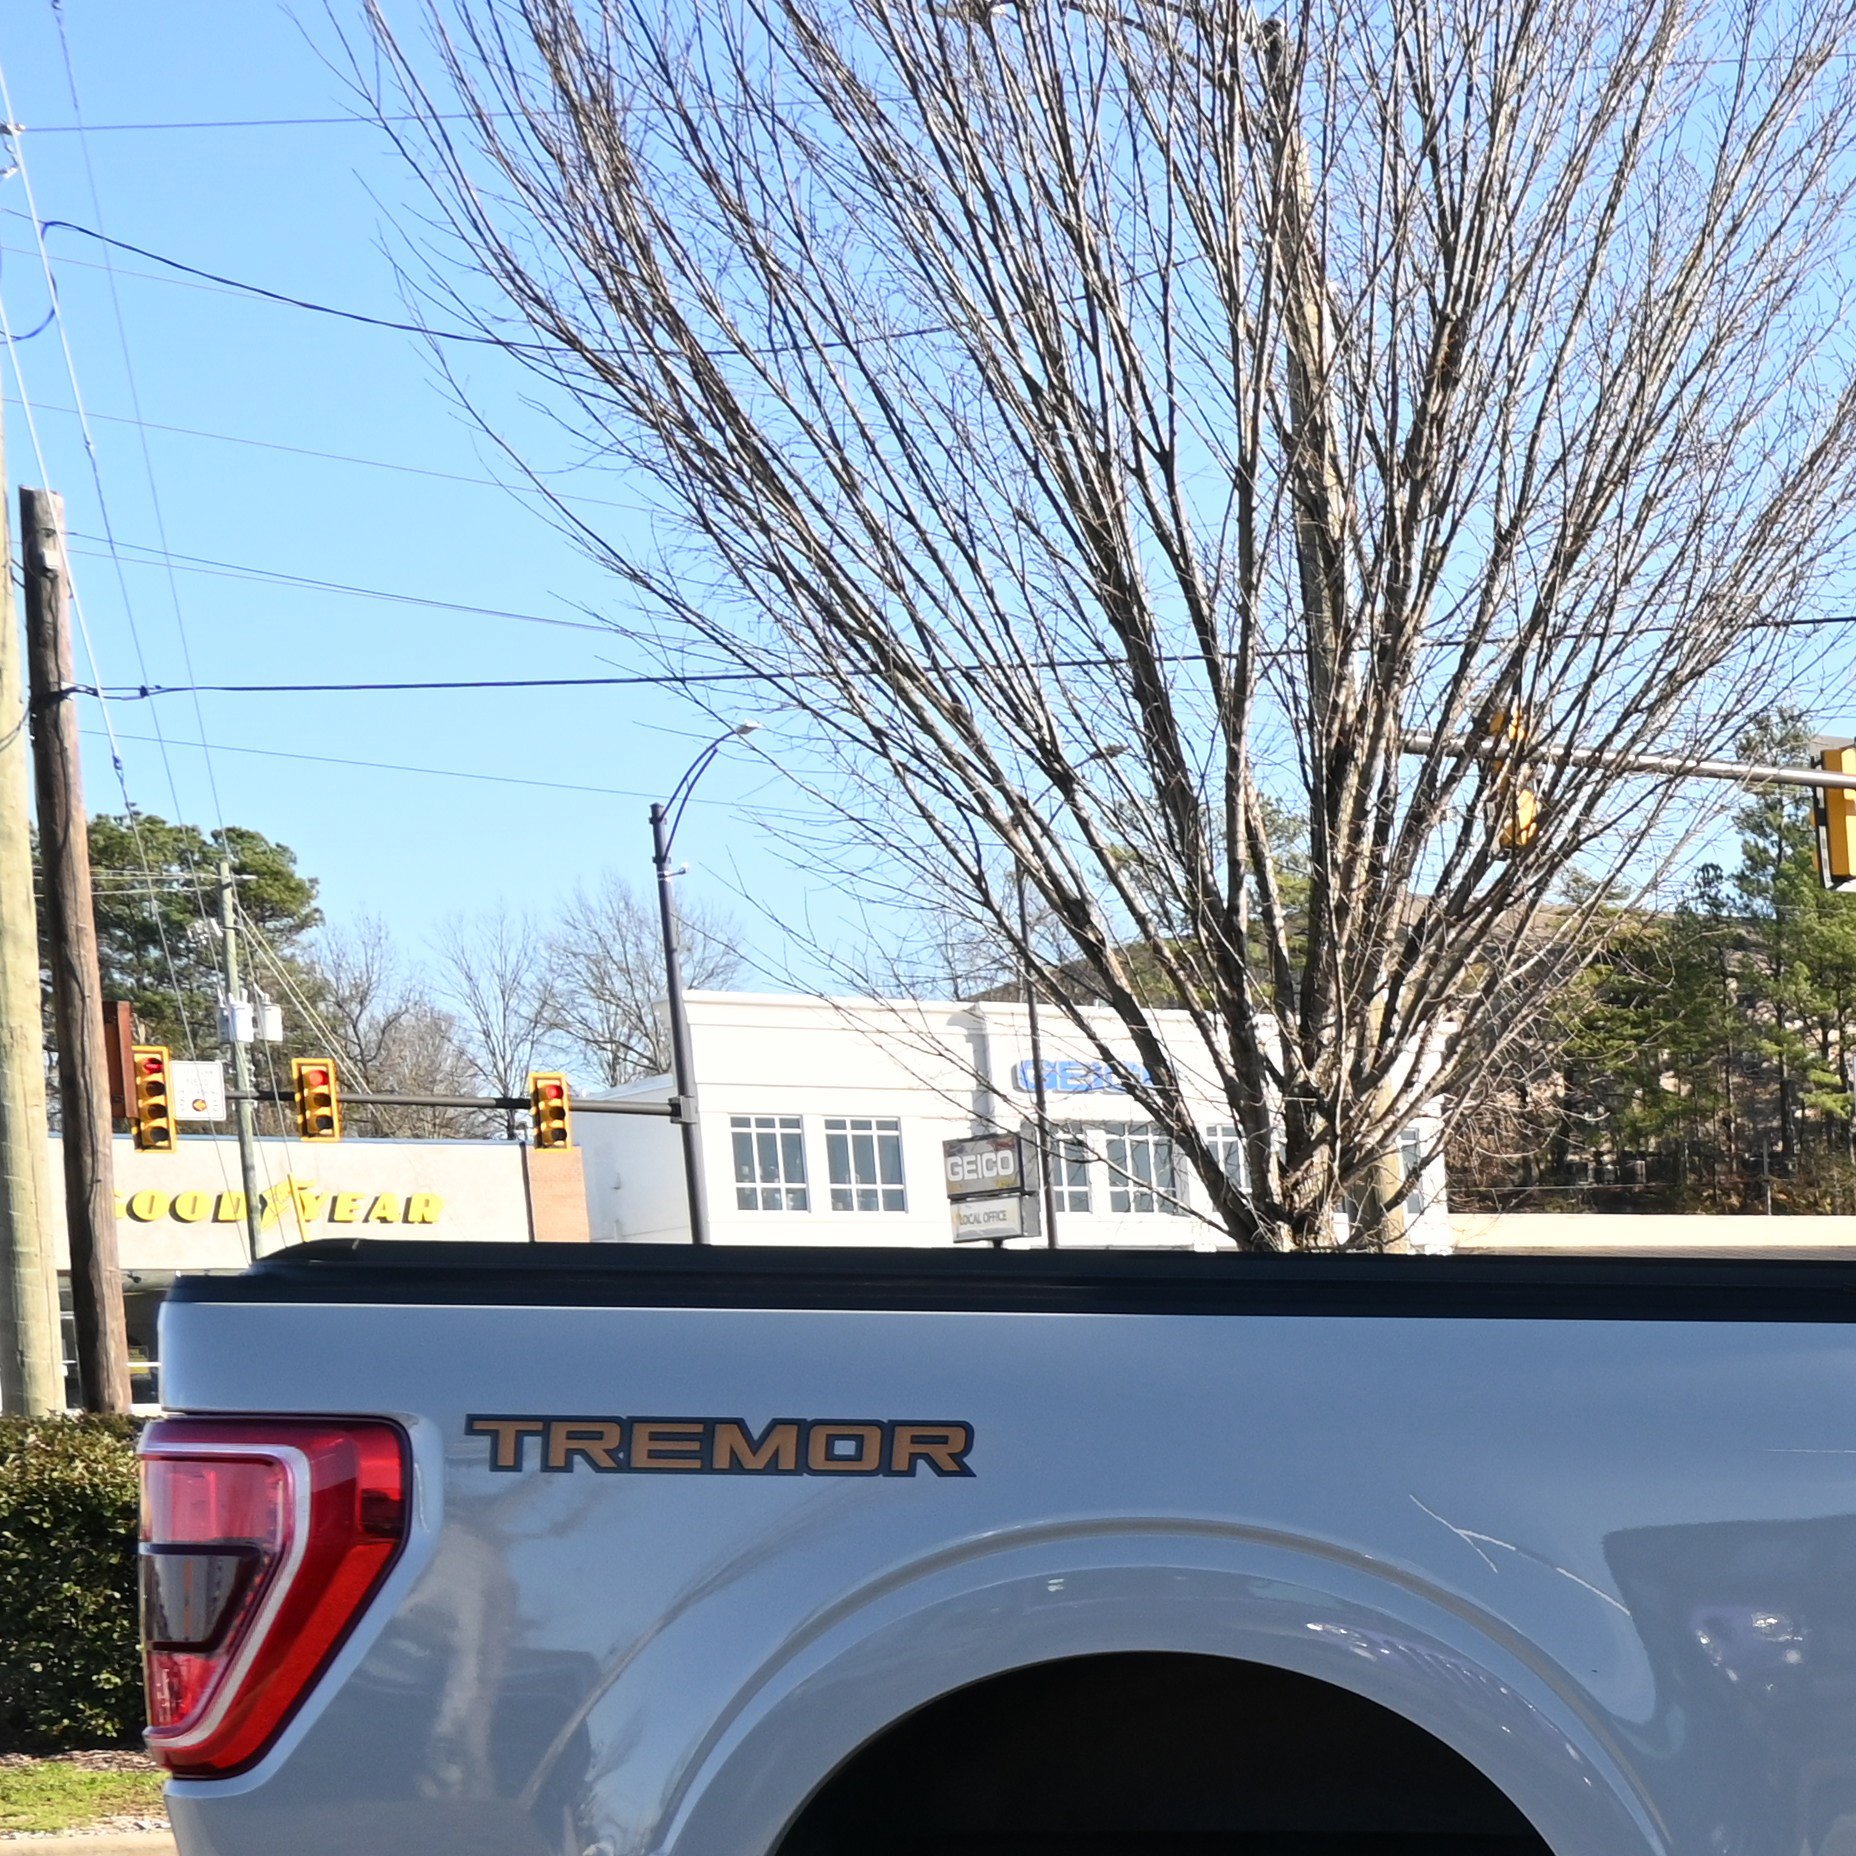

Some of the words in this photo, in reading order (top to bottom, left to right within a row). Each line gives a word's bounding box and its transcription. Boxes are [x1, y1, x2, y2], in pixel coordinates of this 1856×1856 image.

[948, 1149, 1014, 1182] GEICO
[959, 1211, 981, 1226] LOCAL
[983, 1209, 1007, 1223] OFFICE
[466, 1413, 976, 1478] TREMOR
